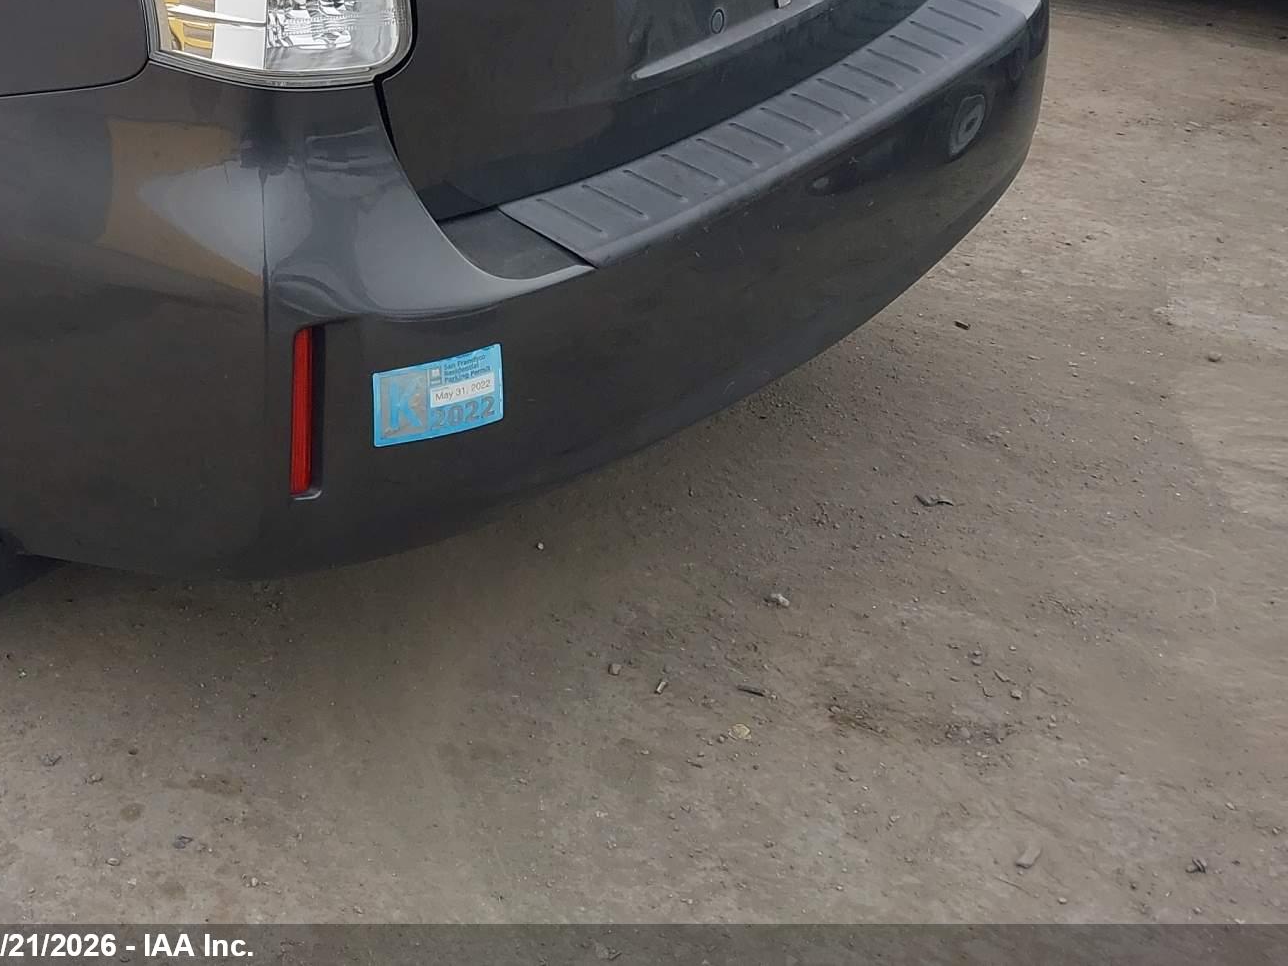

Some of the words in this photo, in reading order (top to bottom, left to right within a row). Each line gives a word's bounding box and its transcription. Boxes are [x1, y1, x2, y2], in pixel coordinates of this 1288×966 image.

[435, 390, 453, 402] May
[471, 379, 491, 393] 2022
[431, 395, 495, 428] 2022
